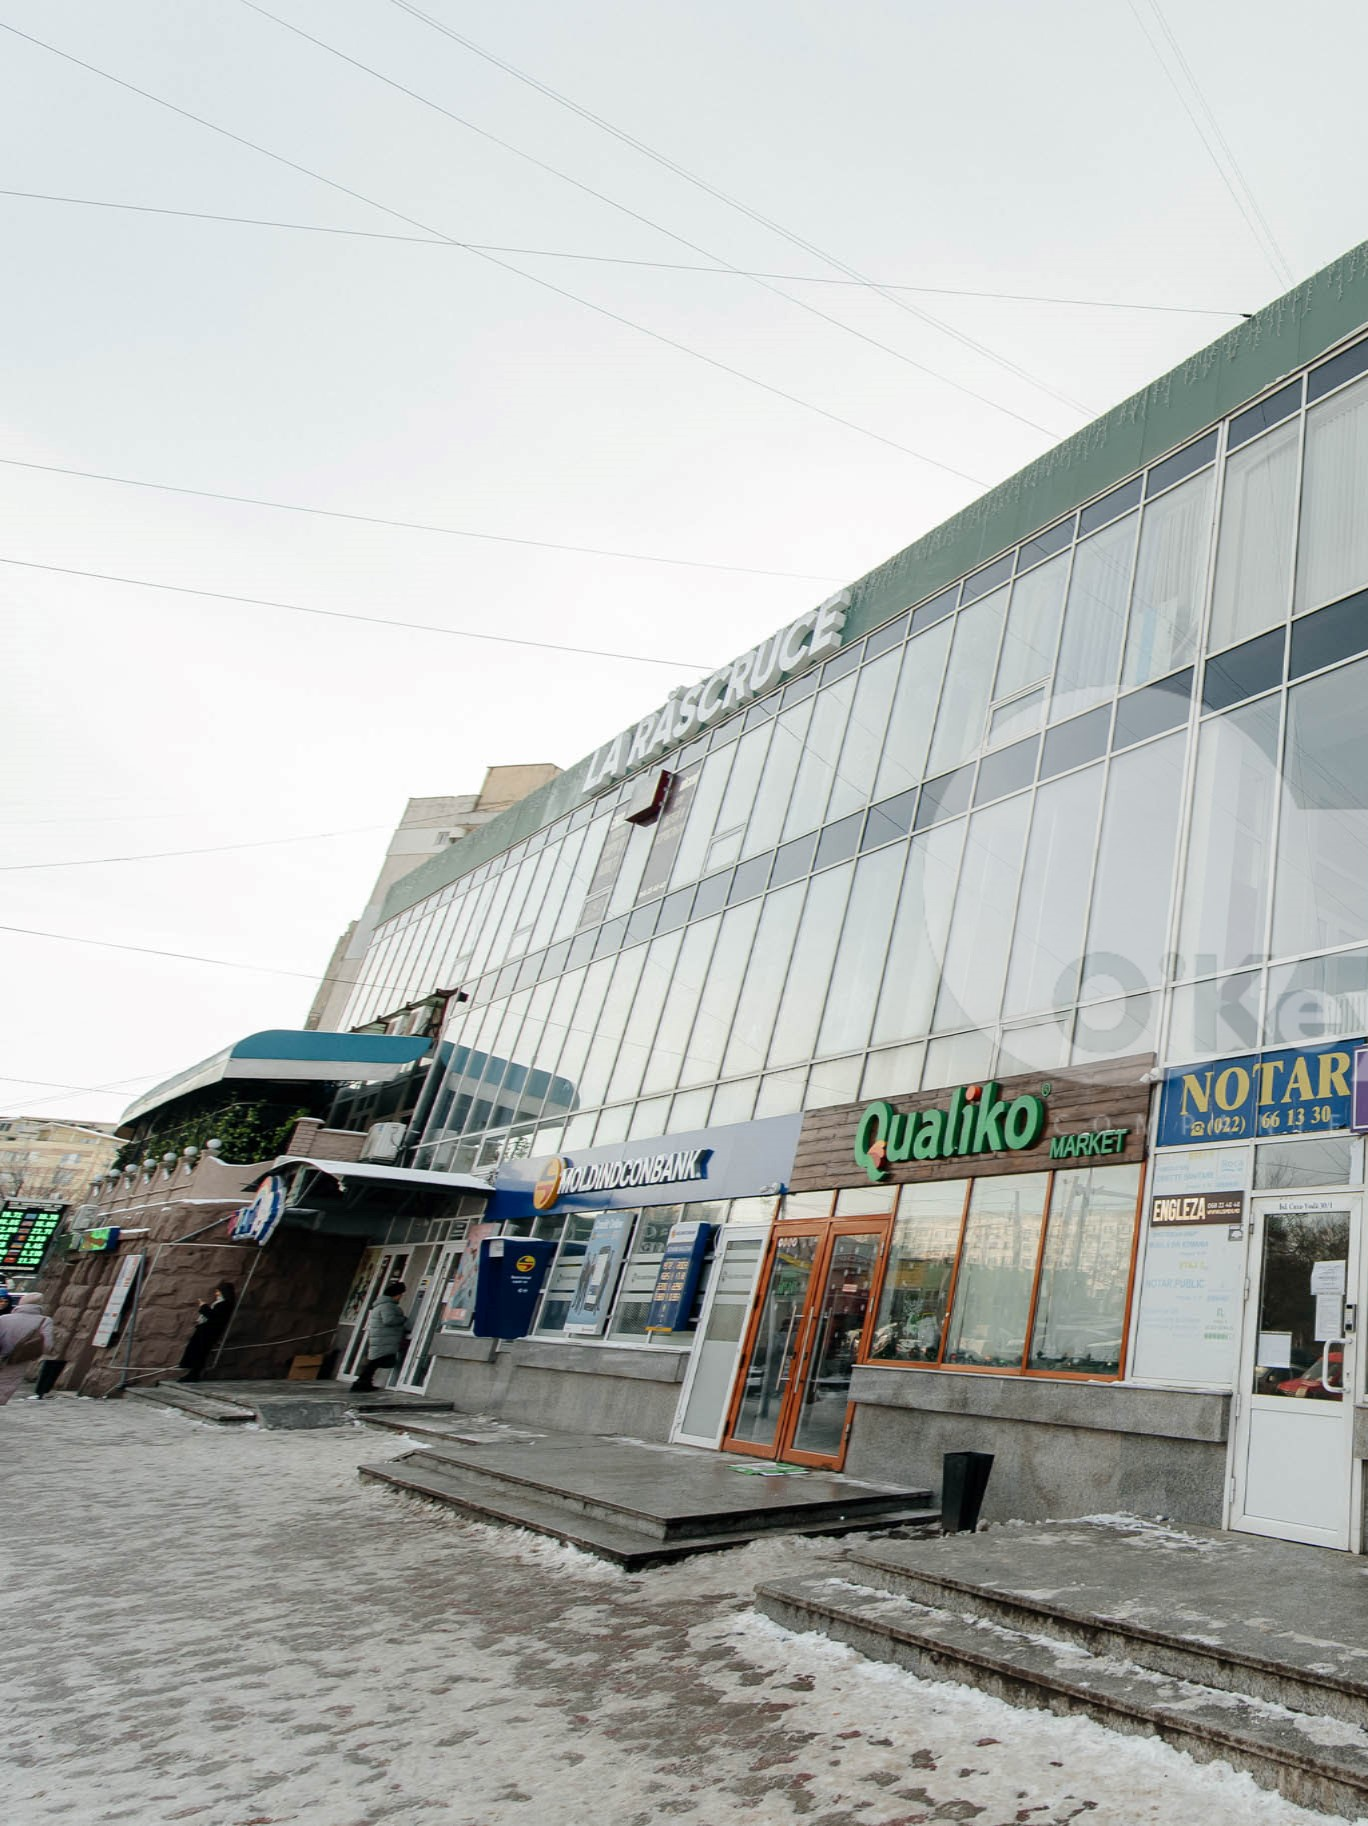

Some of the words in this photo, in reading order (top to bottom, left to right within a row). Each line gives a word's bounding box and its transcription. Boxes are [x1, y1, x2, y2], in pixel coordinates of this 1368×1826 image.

[583, 731, 633, 796] LA
[1180, 1052, 1353, 1117] NOTAR
[854, 1081, 1046, 1183] Qualiko
[1049, 1128, 1131, 1160] MARKET
[1206, 1115, 1247, 1136] (022)
[1261, 1110, 1281, 1129] 66
[1287, 1108, 1305, 1127] 13
[1310, 1105, 1333, 1125] 30
[557, 1148, 711, 1195] MOLDINDCONBANK
[1153, 1197, 1206, 1222] ENGLEZA
